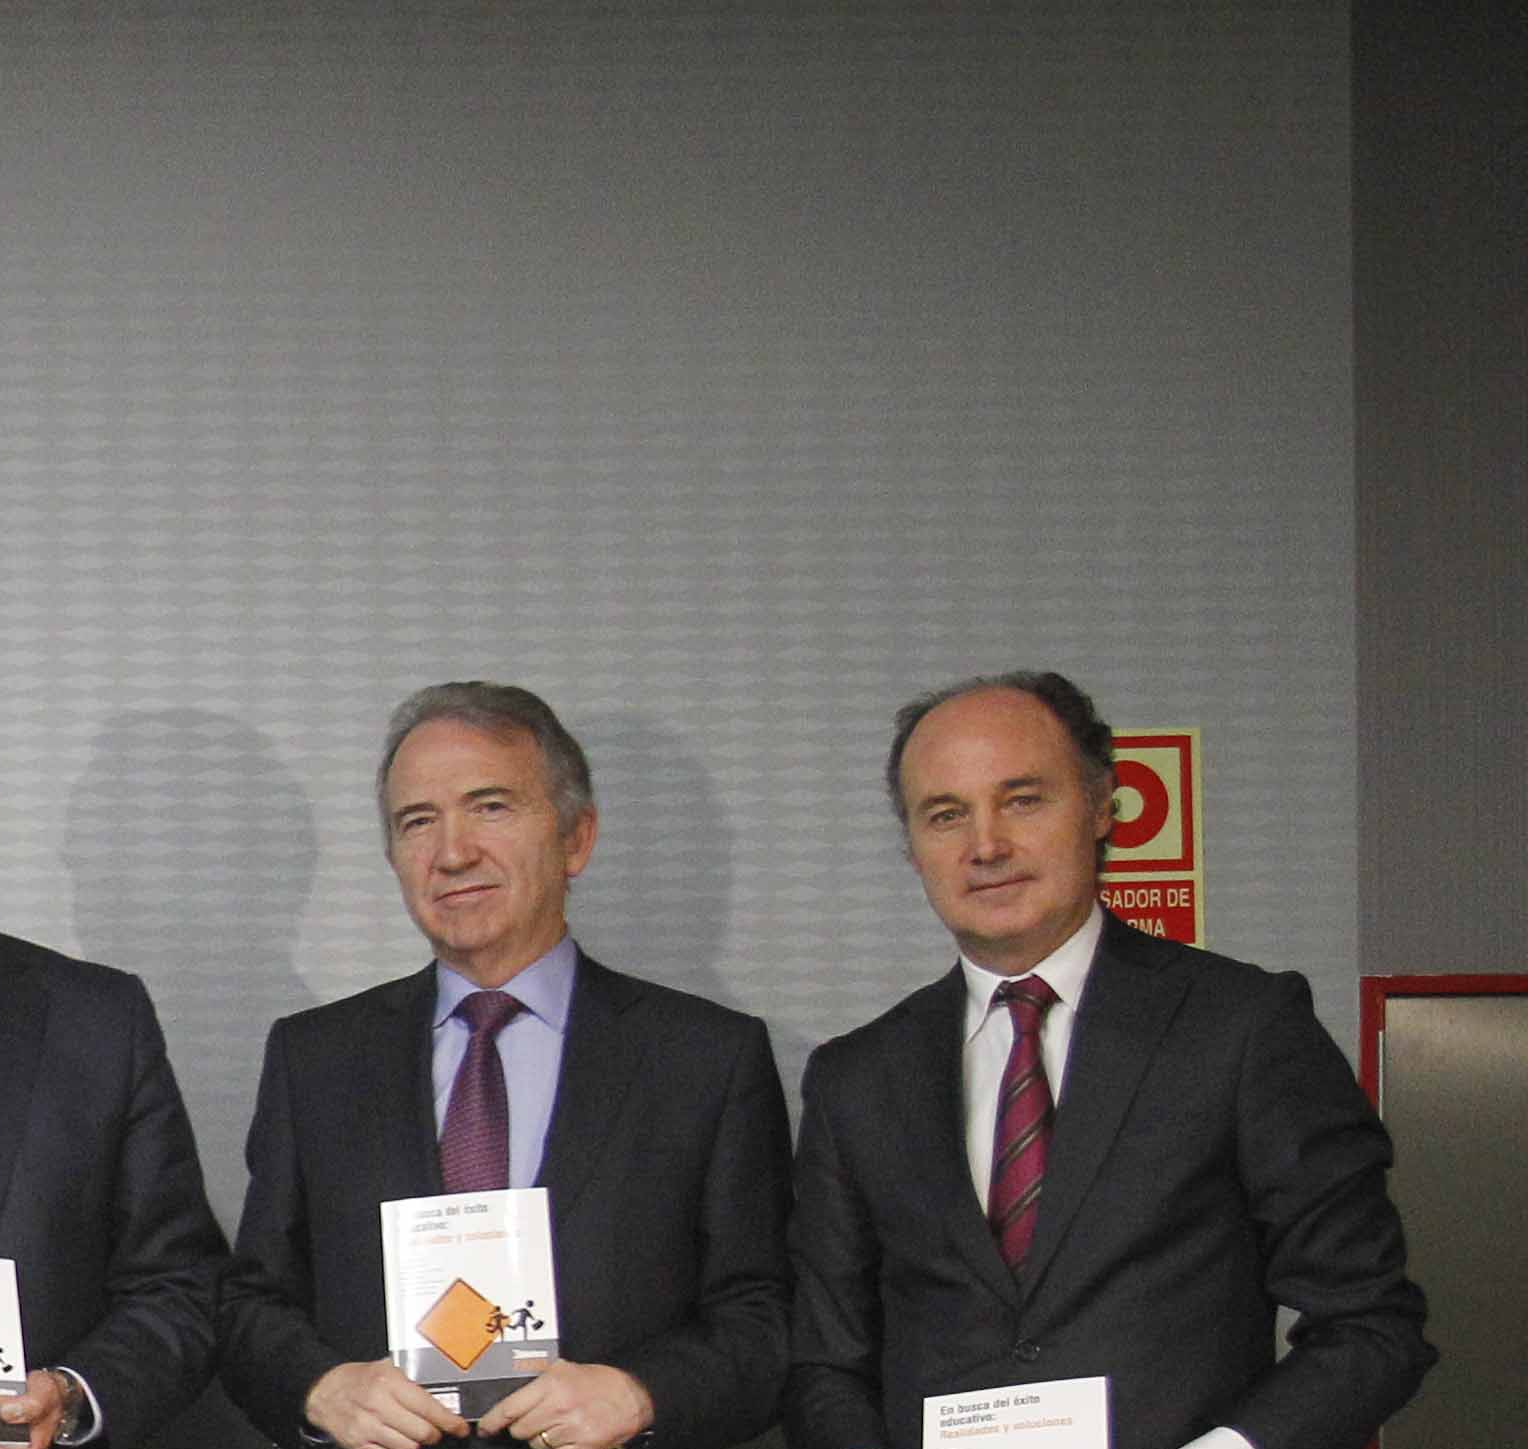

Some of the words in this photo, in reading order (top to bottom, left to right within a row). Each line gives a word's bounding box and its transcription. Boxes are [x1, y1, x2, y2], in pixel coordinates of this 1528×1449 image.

[1167, 888, 1192, 908] DE
[940, 1405, 954, 1416] En
[958, 1400, 990, 1414] busca
[993, 1398, 1010, 1409] del
[1014, 1393, 1041, 1407] éxito
